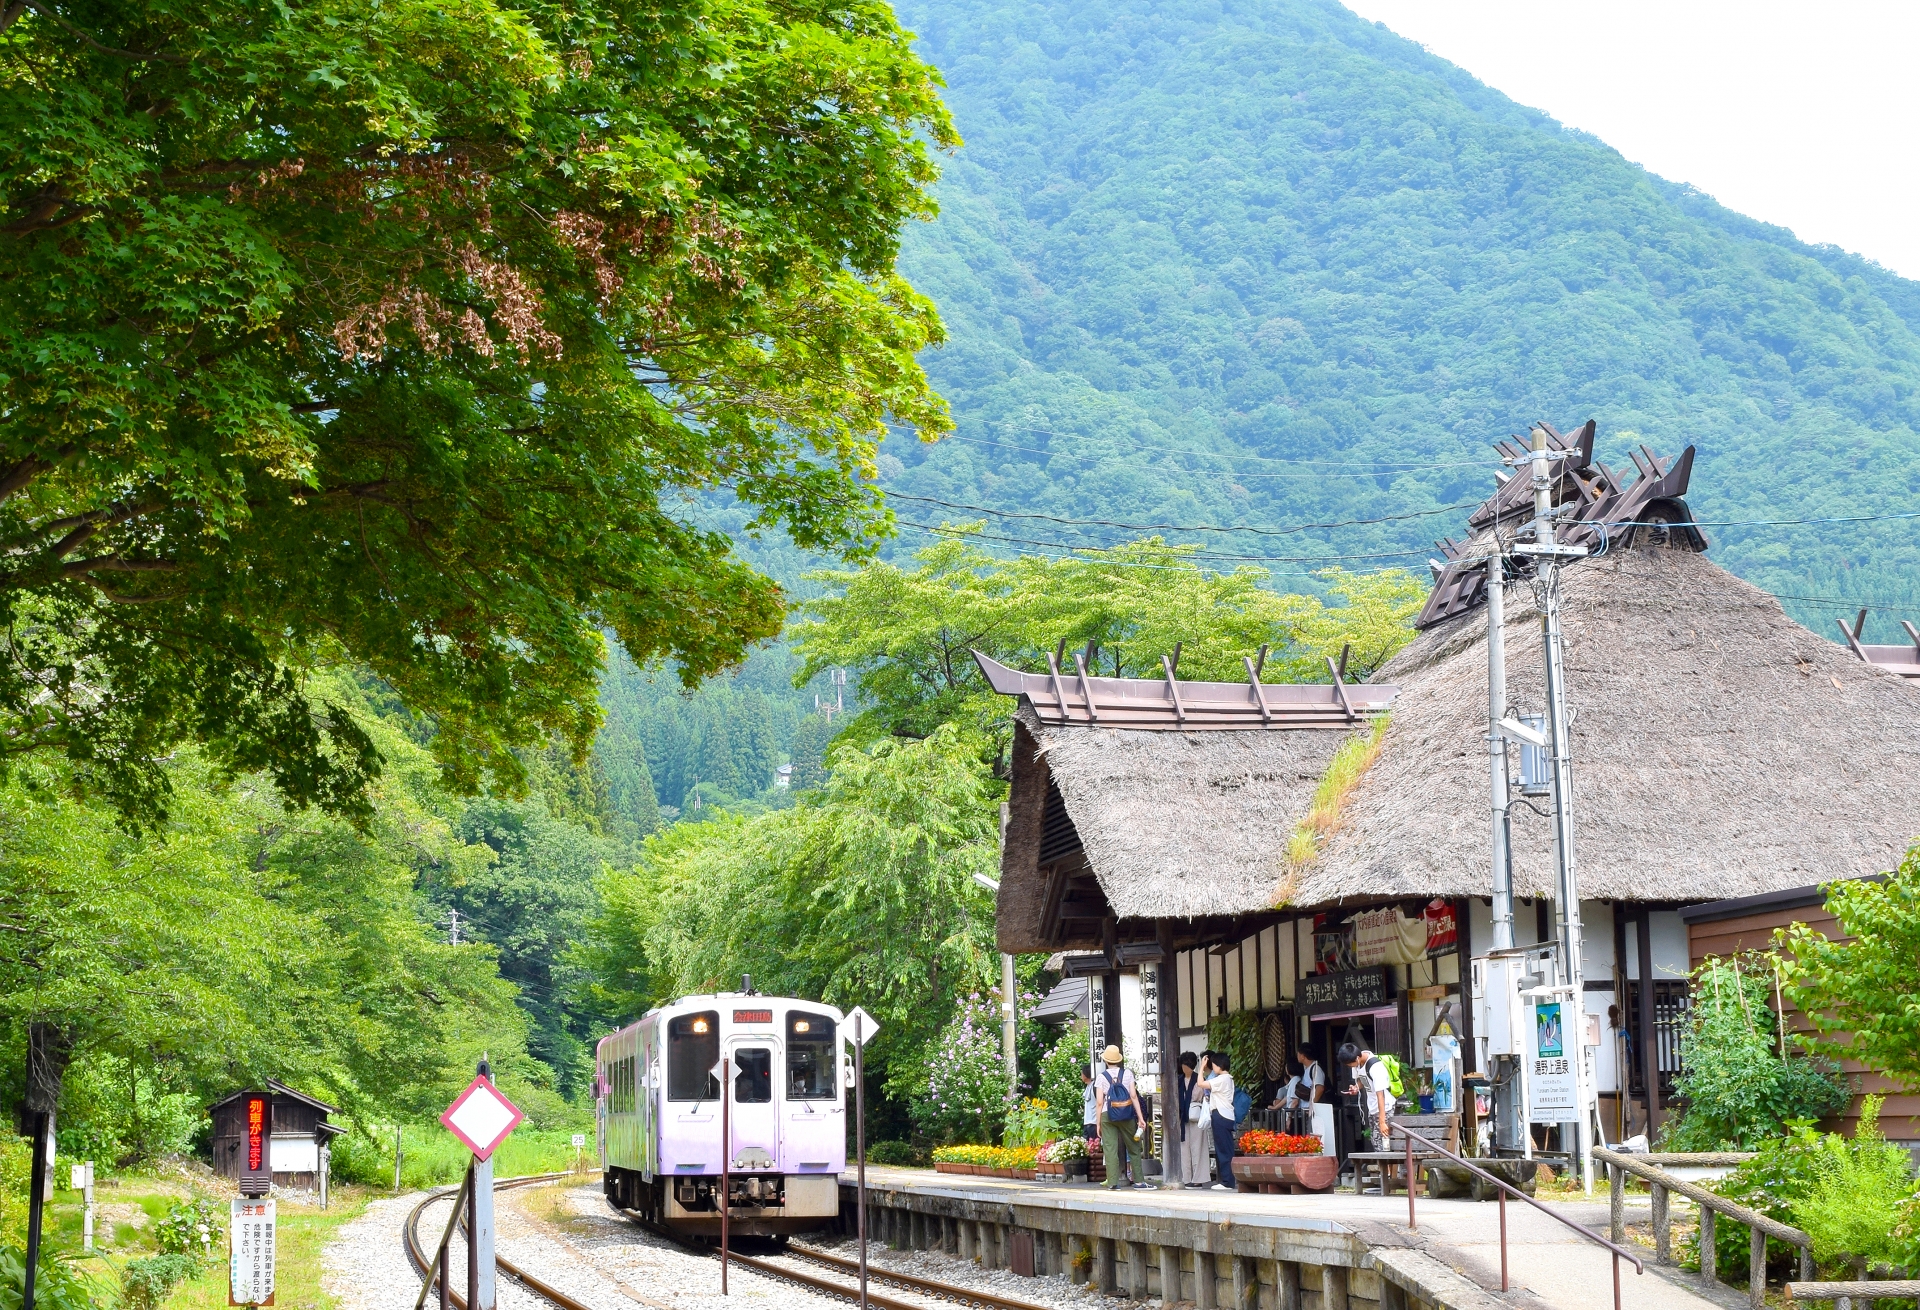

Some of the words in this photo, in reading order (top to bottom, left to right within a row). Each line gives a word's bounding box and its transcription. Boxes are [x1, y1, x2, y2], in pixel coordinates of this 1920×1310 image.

[1145, 972, 1159, 1064] 湯野上温泉駅
[1534, 1059, 1569, 1075] 湯野上温泉
[249, 1100, 262, 1170] 列車がきます
[574, 1136, 584, 1144] 25
